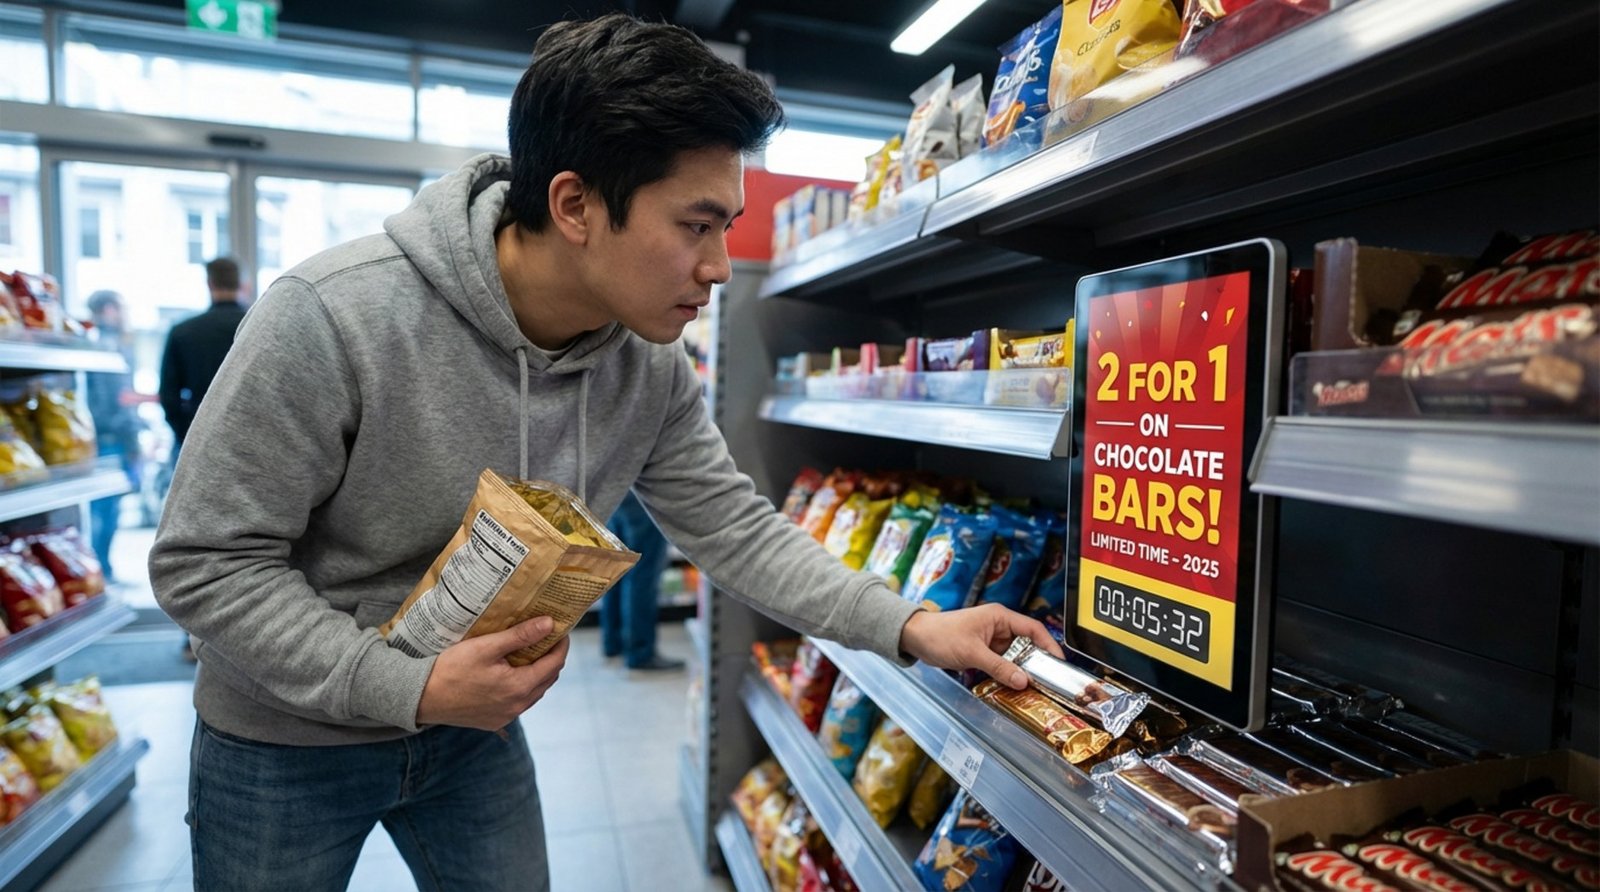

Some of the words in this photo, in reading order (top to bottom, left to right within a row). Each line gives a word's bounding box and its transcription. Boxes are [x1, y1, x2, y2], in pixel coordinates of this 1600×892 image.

[1096, 351, 1120, 401] 2
[1128, 360, 1197, 402] FOR
[1208, 344, 1228, 402] 1
[1139, 413, 1169, 437] ON
[1094, 442, 1224, 480] CHOCOLATE
[1092, 473, 1222, 545] BARS!
[1091, 531, 1135, 556] LIMITED
[1138, 543, 1169, 566] TIME
[1182, 553, 1220, 579] 2025
[1099, 585, 1203, 652] 00:05:32
